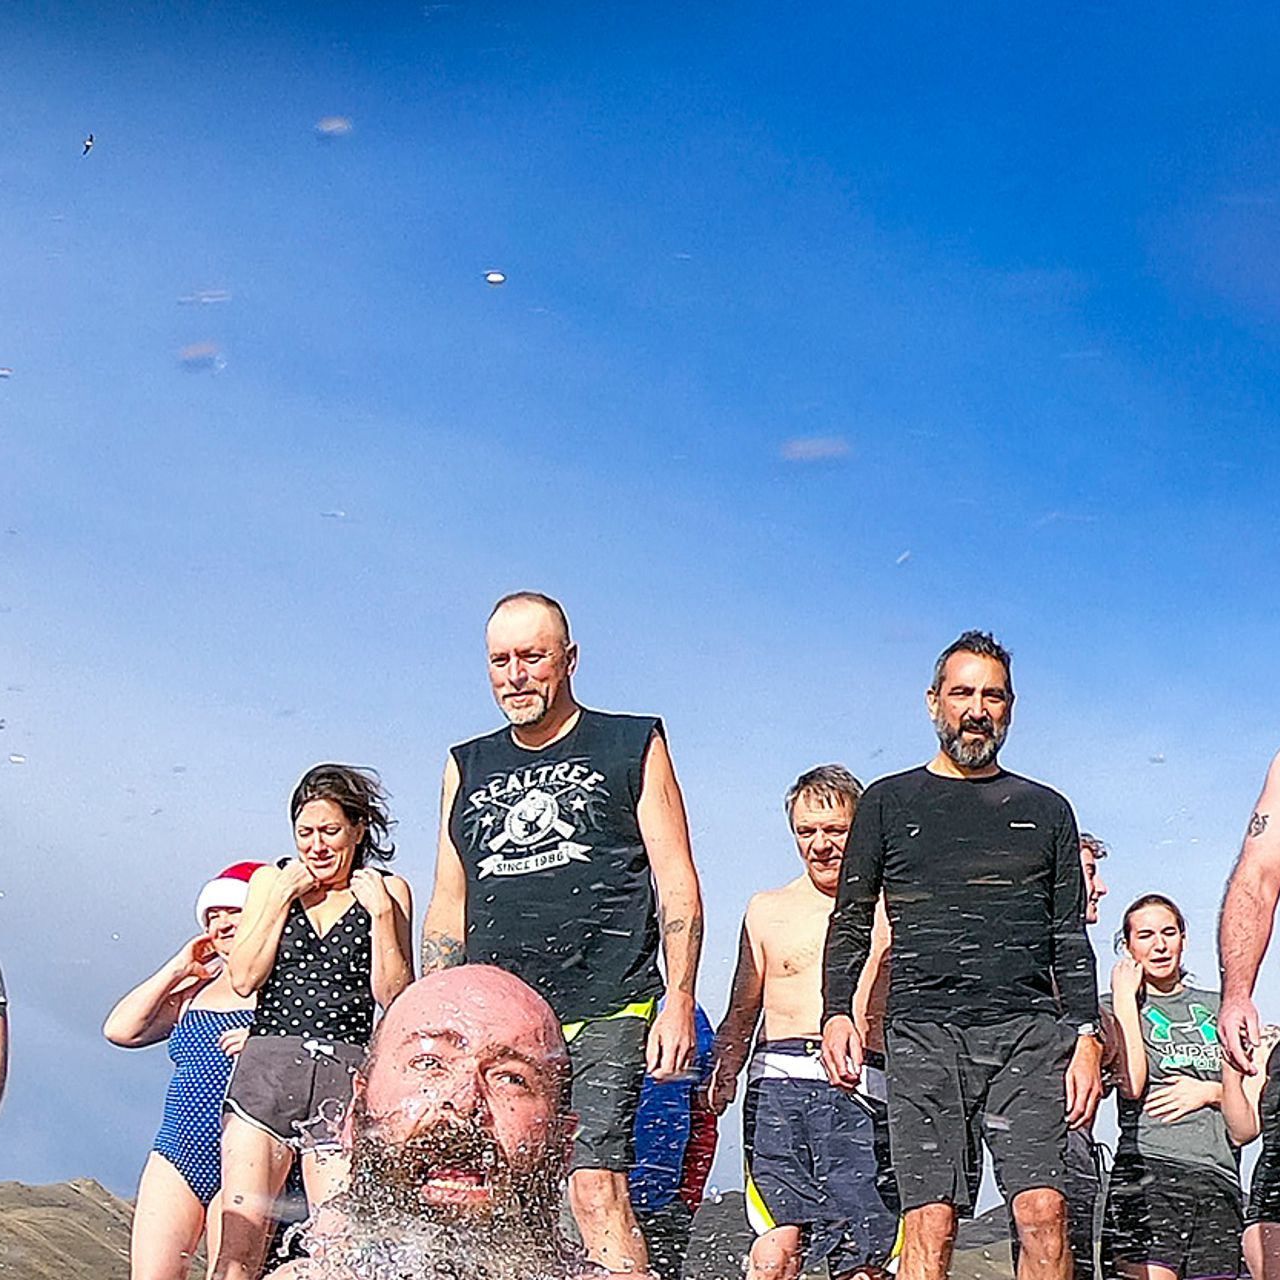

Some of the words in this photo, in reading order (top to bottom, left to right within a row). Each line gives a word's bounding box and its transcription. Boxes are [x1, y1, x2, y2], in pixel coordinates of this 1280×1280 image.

[469, 762, 606, 810] REALTREE
[496, 860, 531, 873] SINCE
[535, 851, 564, 867] 1986
